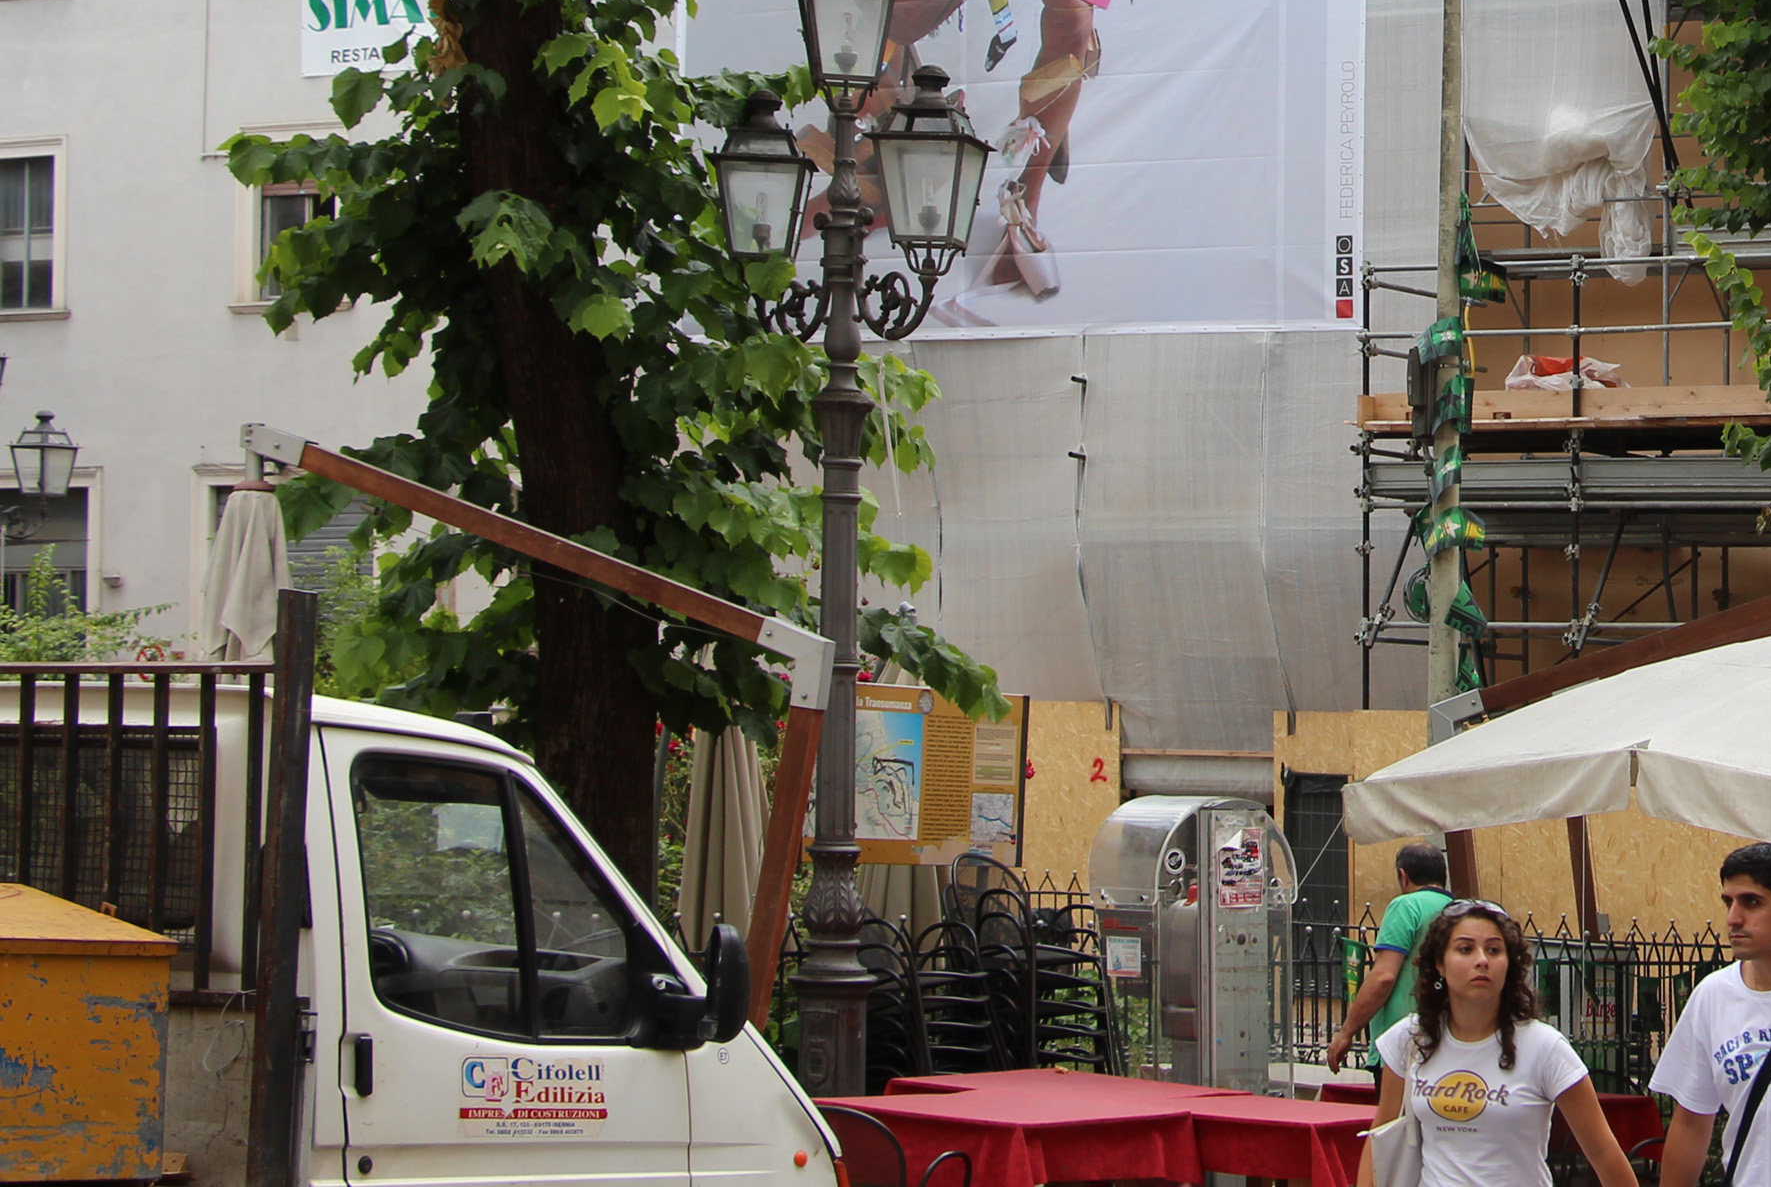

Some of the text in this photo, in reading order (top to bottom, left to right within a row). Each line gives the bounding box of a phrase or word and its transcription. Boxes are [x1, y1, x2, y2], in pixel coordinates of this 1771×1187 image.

[1339, 60, 1355, 219] FEDERICA PEYROLO
[1090, 758, 1107, 782] 2
[511, 1057, 603, 1081] Cifolell
[512, 1080, 606, 1104] Edilizia
[1413, 1079, 1510, 1106] Hard Rock
[518, 1109, 529, 1119] DI
[530, 1109, 600, 1119] COSTRUZIONI
[1443, 1104, 1470, 1114] CAFE
[1457, 1125, 1479, 1133] YORK
